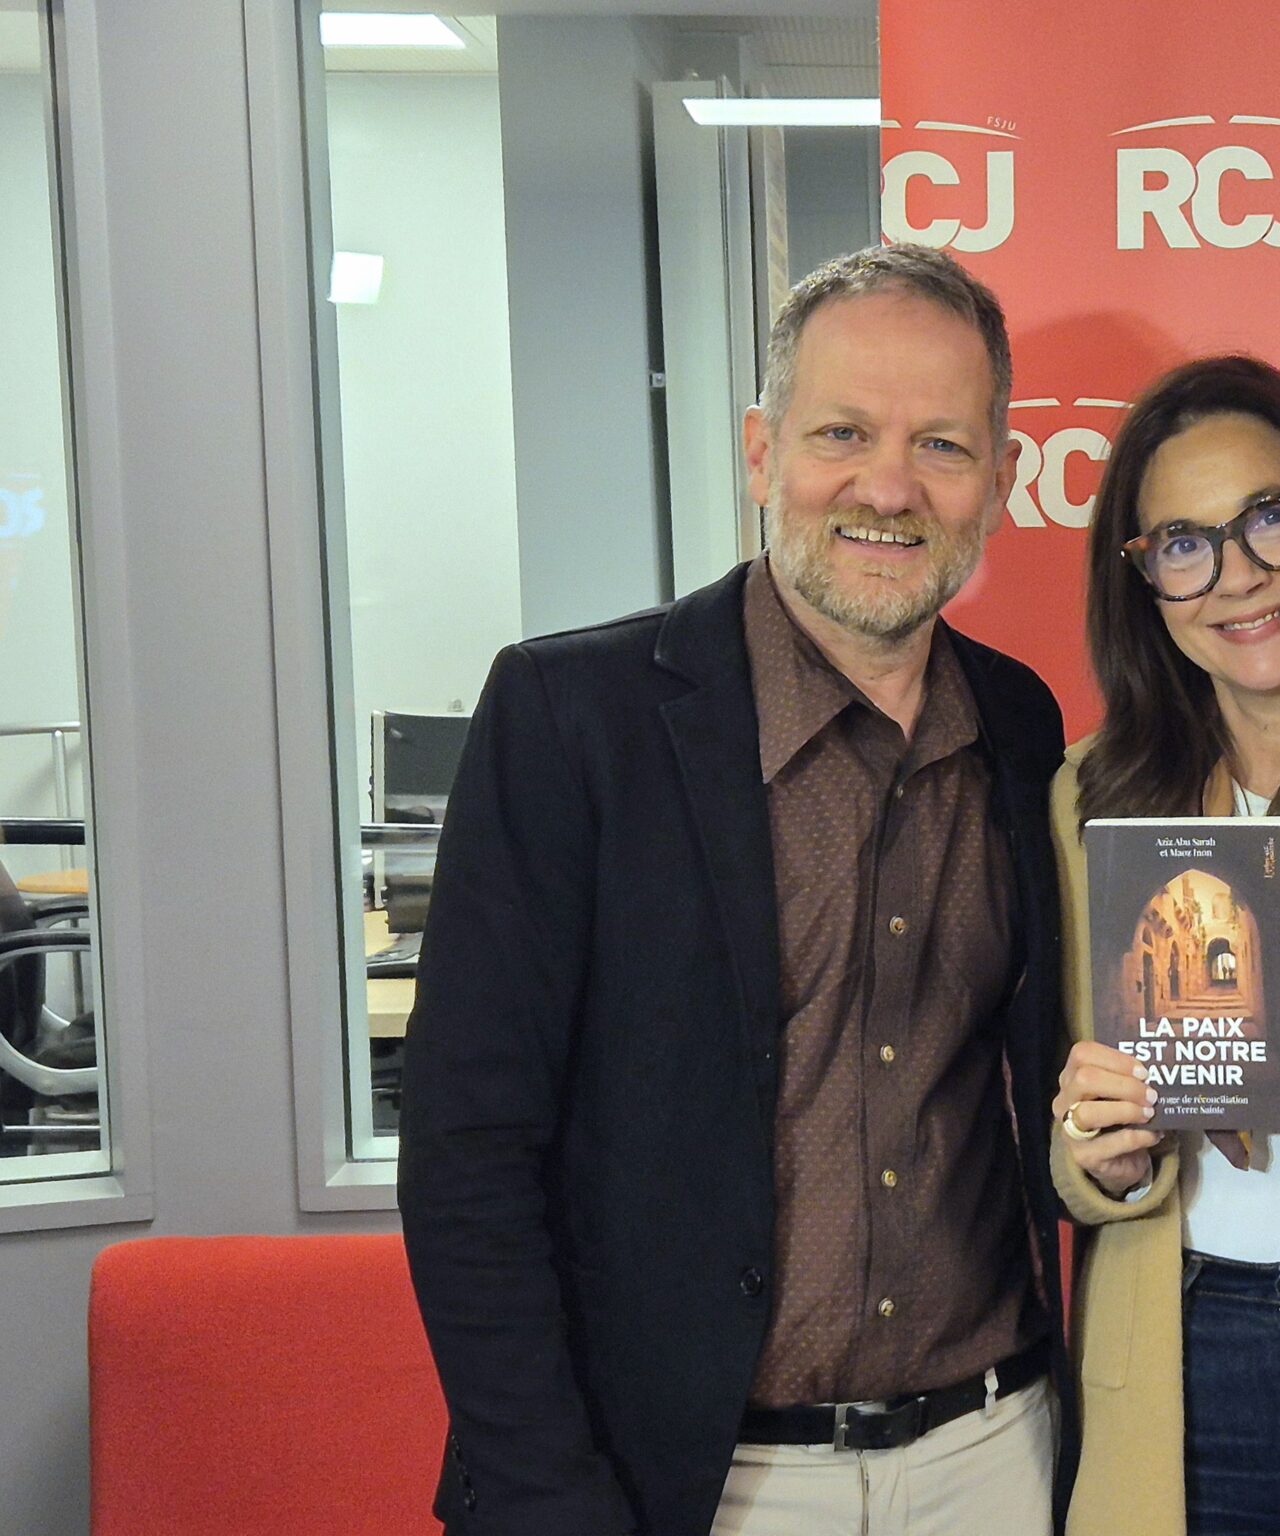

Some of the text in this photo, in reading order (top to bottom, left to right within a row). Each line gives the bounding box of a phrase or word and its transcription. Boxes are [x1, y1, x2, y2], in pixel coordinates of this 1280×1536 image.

[986, 115, 1017, 131] FSJU
[881, 150, 1014, 252] CJ
[1155, 836, 1216, 846] Aziz Abu Sarah
[1159, 849, 1168, 857] et
[1139, 1017, 1245, 1038] LA PAIX
[1118, 1041, 1267, 1062] EST NOTRE
[1145, 1064, 1244, 1085] AVENIR
[1182, 1094, 1193, 1104] de
[1194, 1094, 1249, 1105] réconciliation
[1177, 1106, 1198, 1114] Terre
[1200, 1105, 1225, 1114] Sainte
